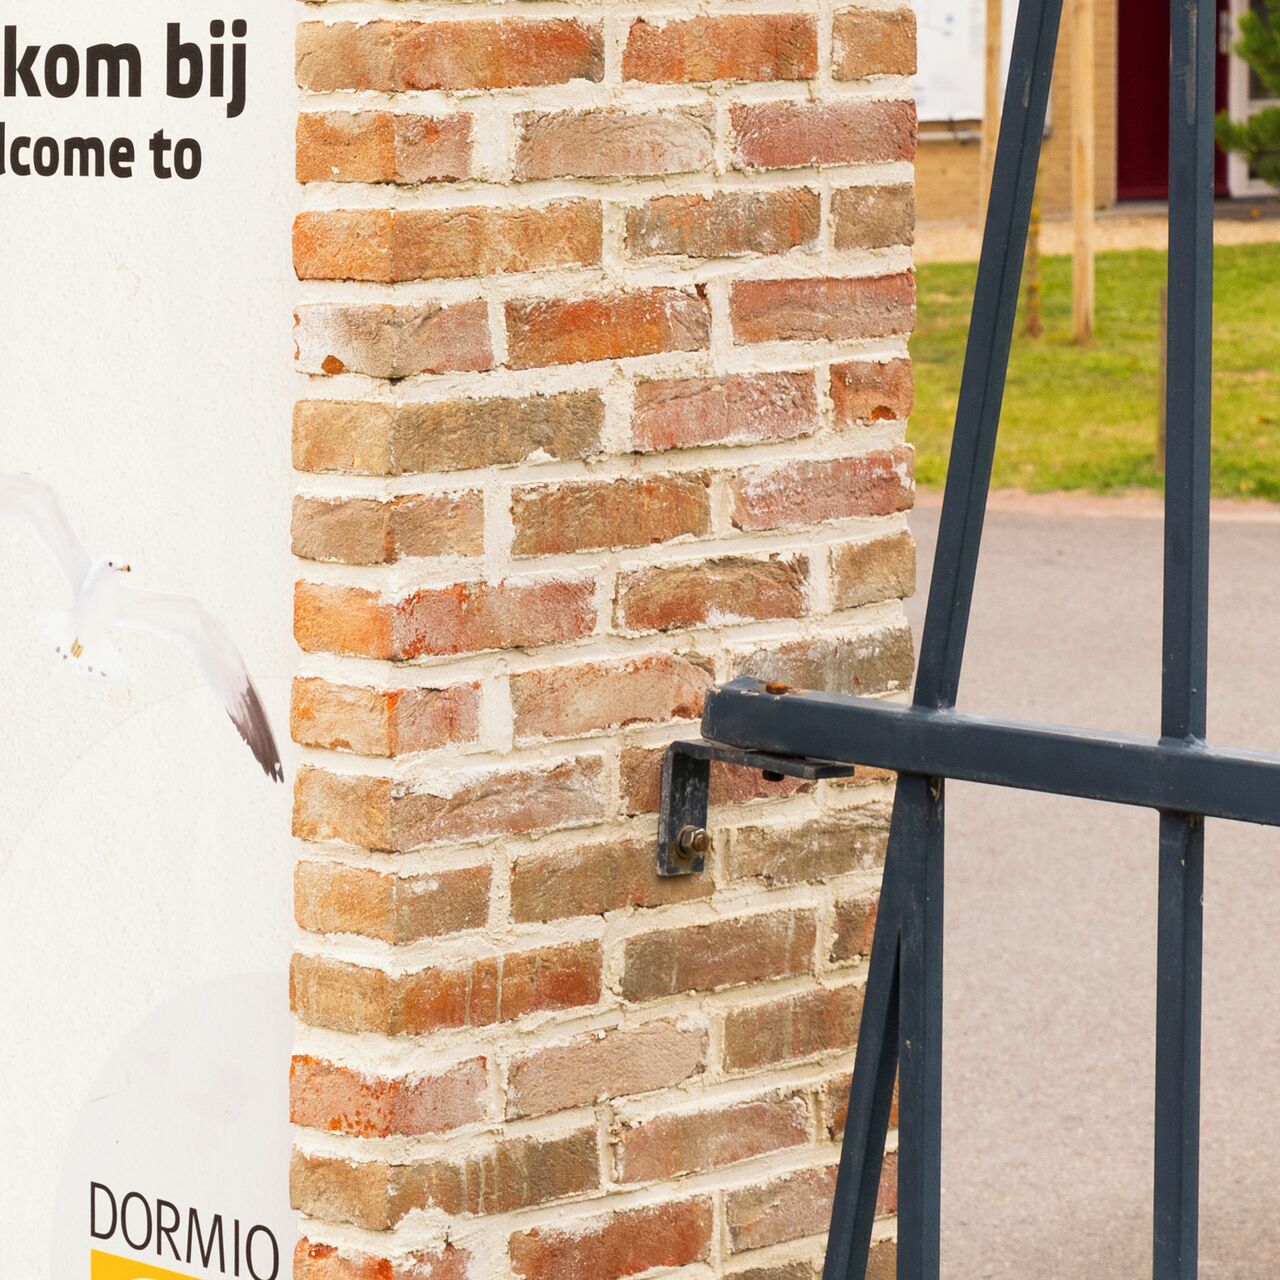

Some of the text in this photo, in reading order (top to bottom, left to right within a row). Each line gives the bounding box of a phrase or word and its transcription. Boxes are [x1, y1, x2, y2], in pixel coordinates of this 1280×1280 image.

[166, 19, 247, 118] bij
[149, 128, 202, 179] to
[90, 1181, 280, 1280] DORMIO
